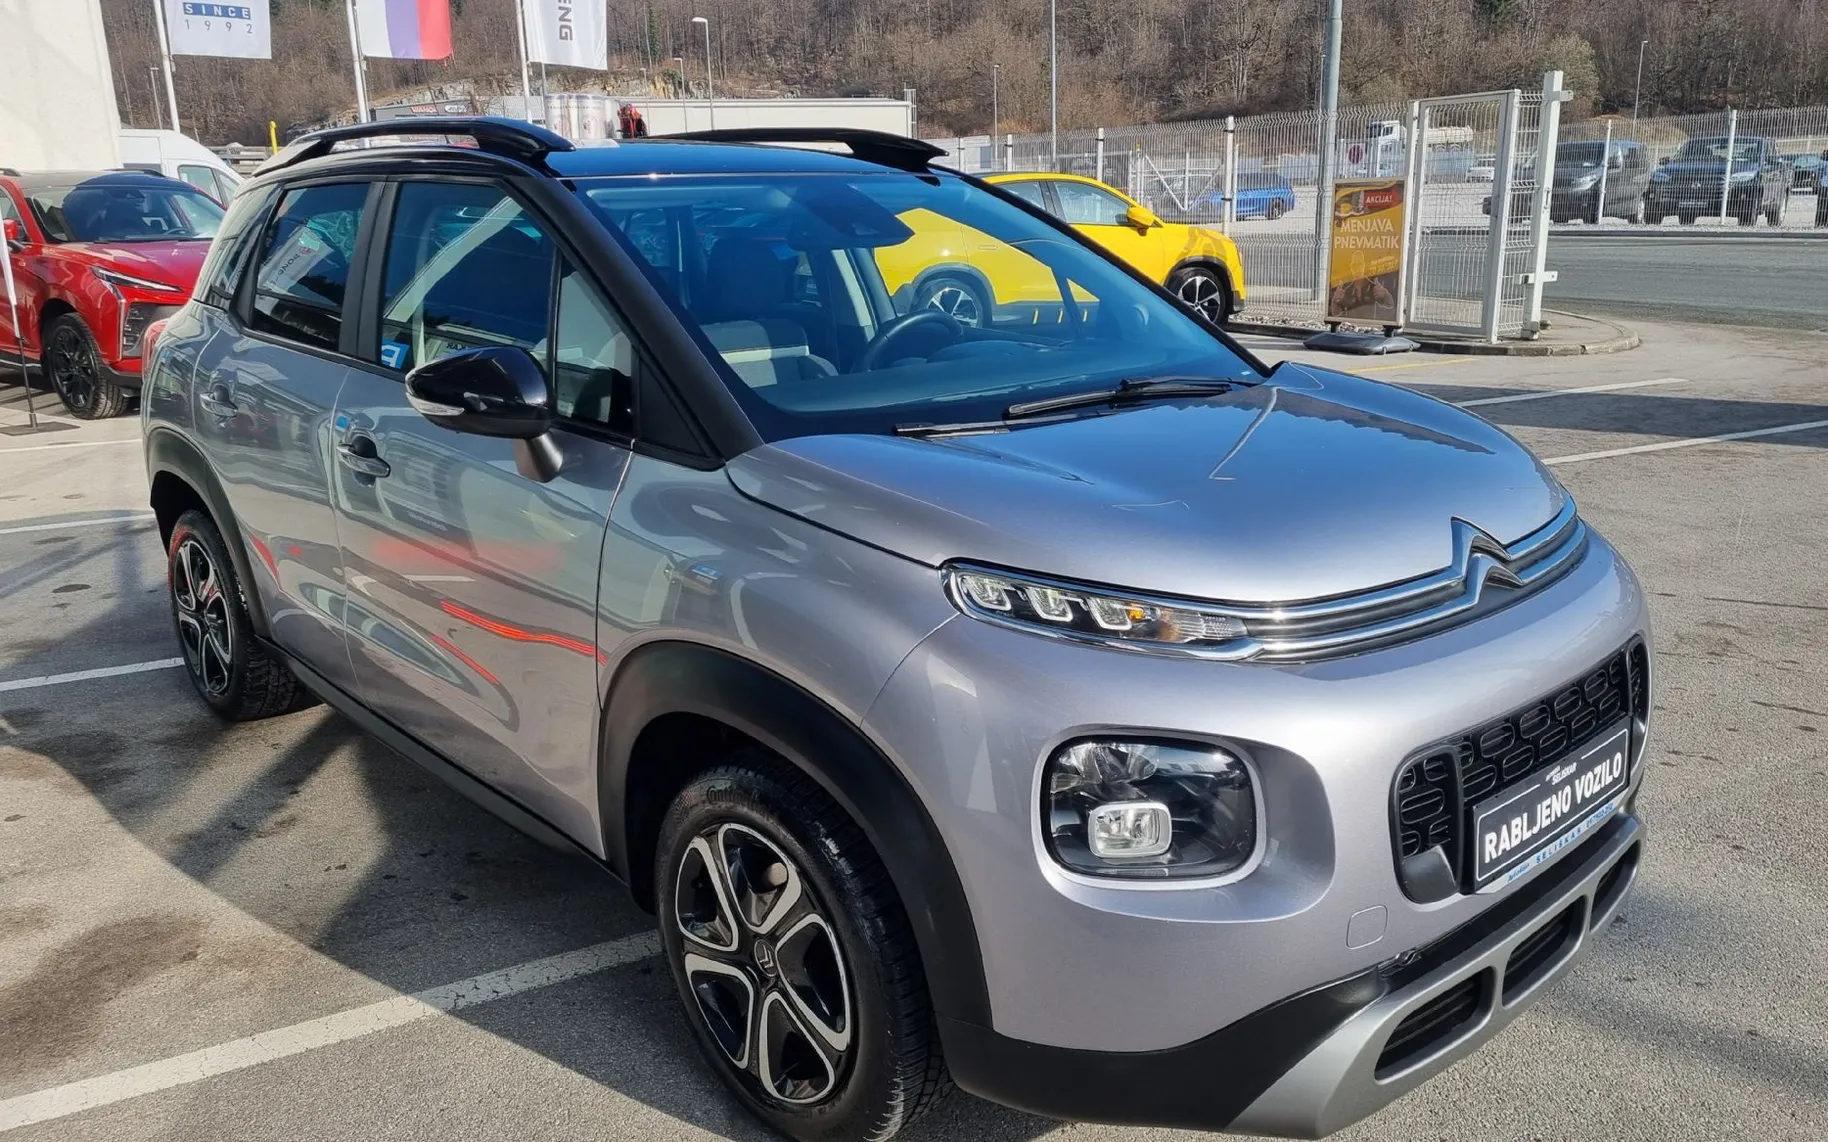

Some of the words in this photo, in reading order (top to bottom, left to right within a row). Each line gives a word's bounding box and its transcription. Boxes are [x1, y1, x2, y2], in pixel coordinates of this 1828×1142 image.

[185, 4, 250, 19] SINCE
[185, 19, 253, 34] 1992
[1366, 195, 1393, 204] AKCIJA!
[1340, 218, 1394, 233] MENJAVA
[1334, 235, 1400, 249] PNEVMATIK
[1484, 785, 1573, 864] RABLJENO
[1575, 752, 1622, 804] VOZILO
